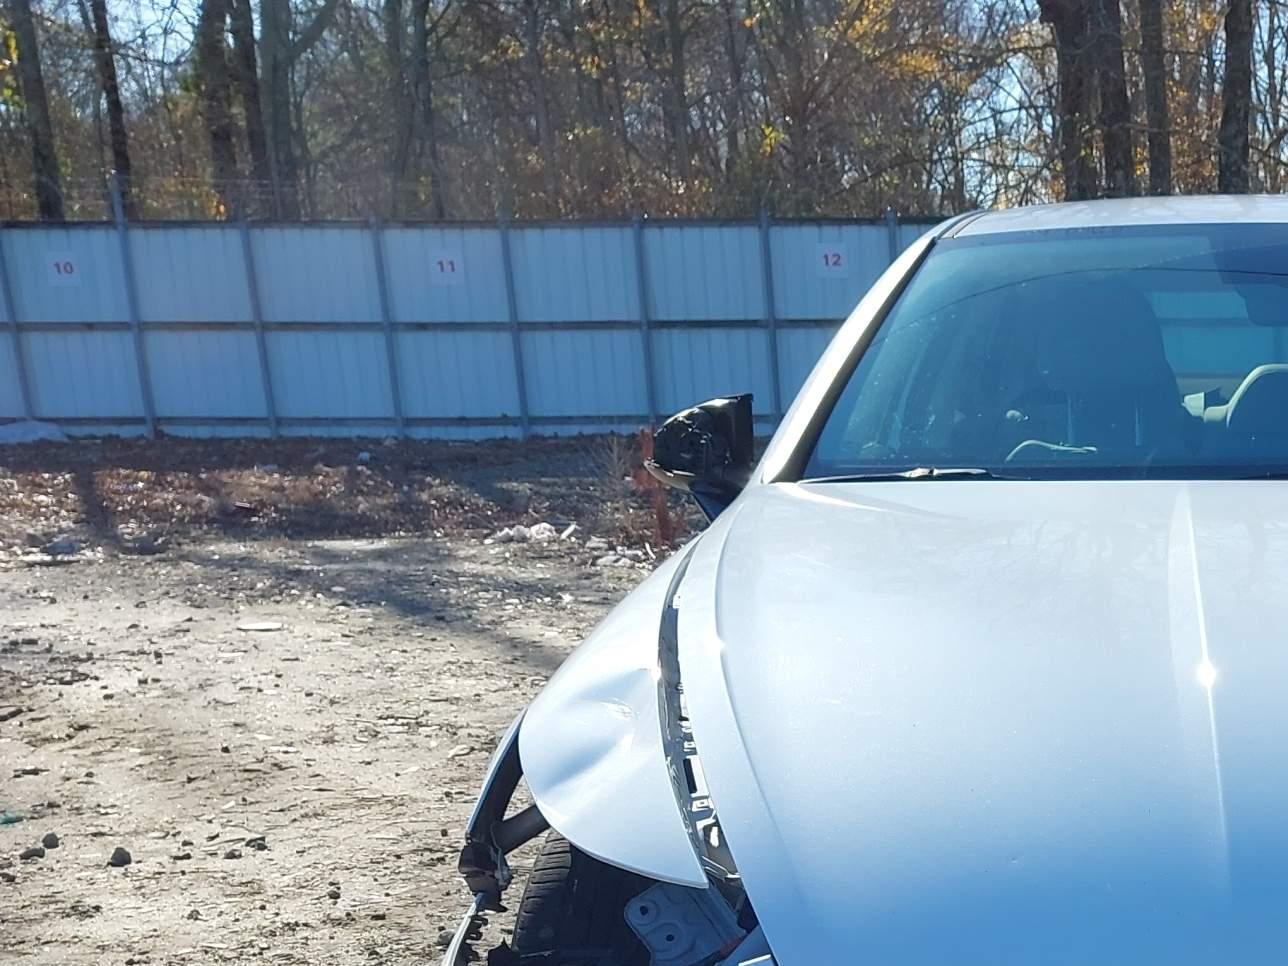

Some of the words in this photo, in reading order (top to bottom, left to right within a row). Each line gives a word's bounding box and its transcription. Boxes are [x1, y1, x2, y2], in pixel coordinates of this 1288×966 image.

[436, 260, 456, 273] 11
[822, 253, 843, 267] 12
[53, 261, 74, 275] 10
